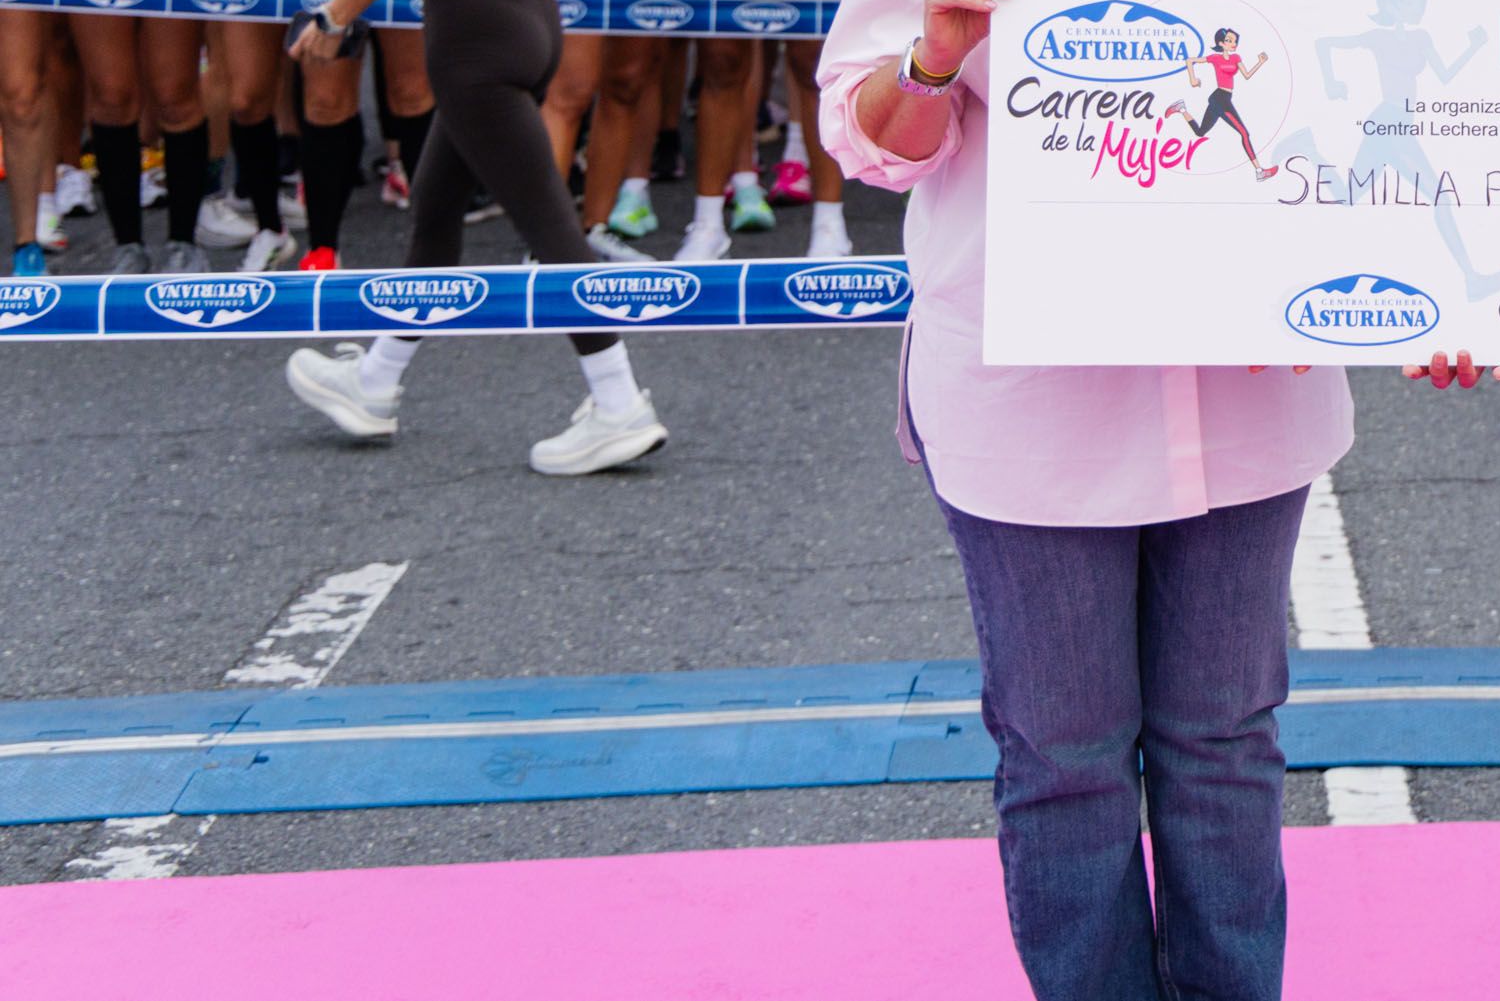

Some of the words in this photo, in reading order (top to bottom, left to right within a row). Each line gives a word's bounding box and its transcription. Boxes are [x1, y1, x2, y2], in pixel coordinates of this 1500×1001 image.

[1066, 27, 1121, 37] CENTRAL
[1129, 28, 1185, 37] LECHERA
[1040, 29, 1189, 61] ASTURIANA
[1007, 76, 1155, 120] Carrera
[1405, 98, 1426, 113] La
[1357, 121, 1423, 135] “Central
[1431, 122, 1498, 136] Lechera
[1042, 123, 1069, 151] de
[1075, 122, 1095, 151] la
[1090, 117, 1210, 188] Mujer
[1276, 156, 1460, 207] SEMILLA
[157, 282, 264, 306] ASTURIANA
[371, 279, 478, 303] ASTURIANA
[583, 276, 690, 300] ASTURIANA
[796, 272, 901, 297] ASTURIANA
[1321, 298, 1369, 306] CENTRAL
[1375, 298, 1424, 307] LECHERA
[1299, 306, 1427, 328] ASTURIANA
